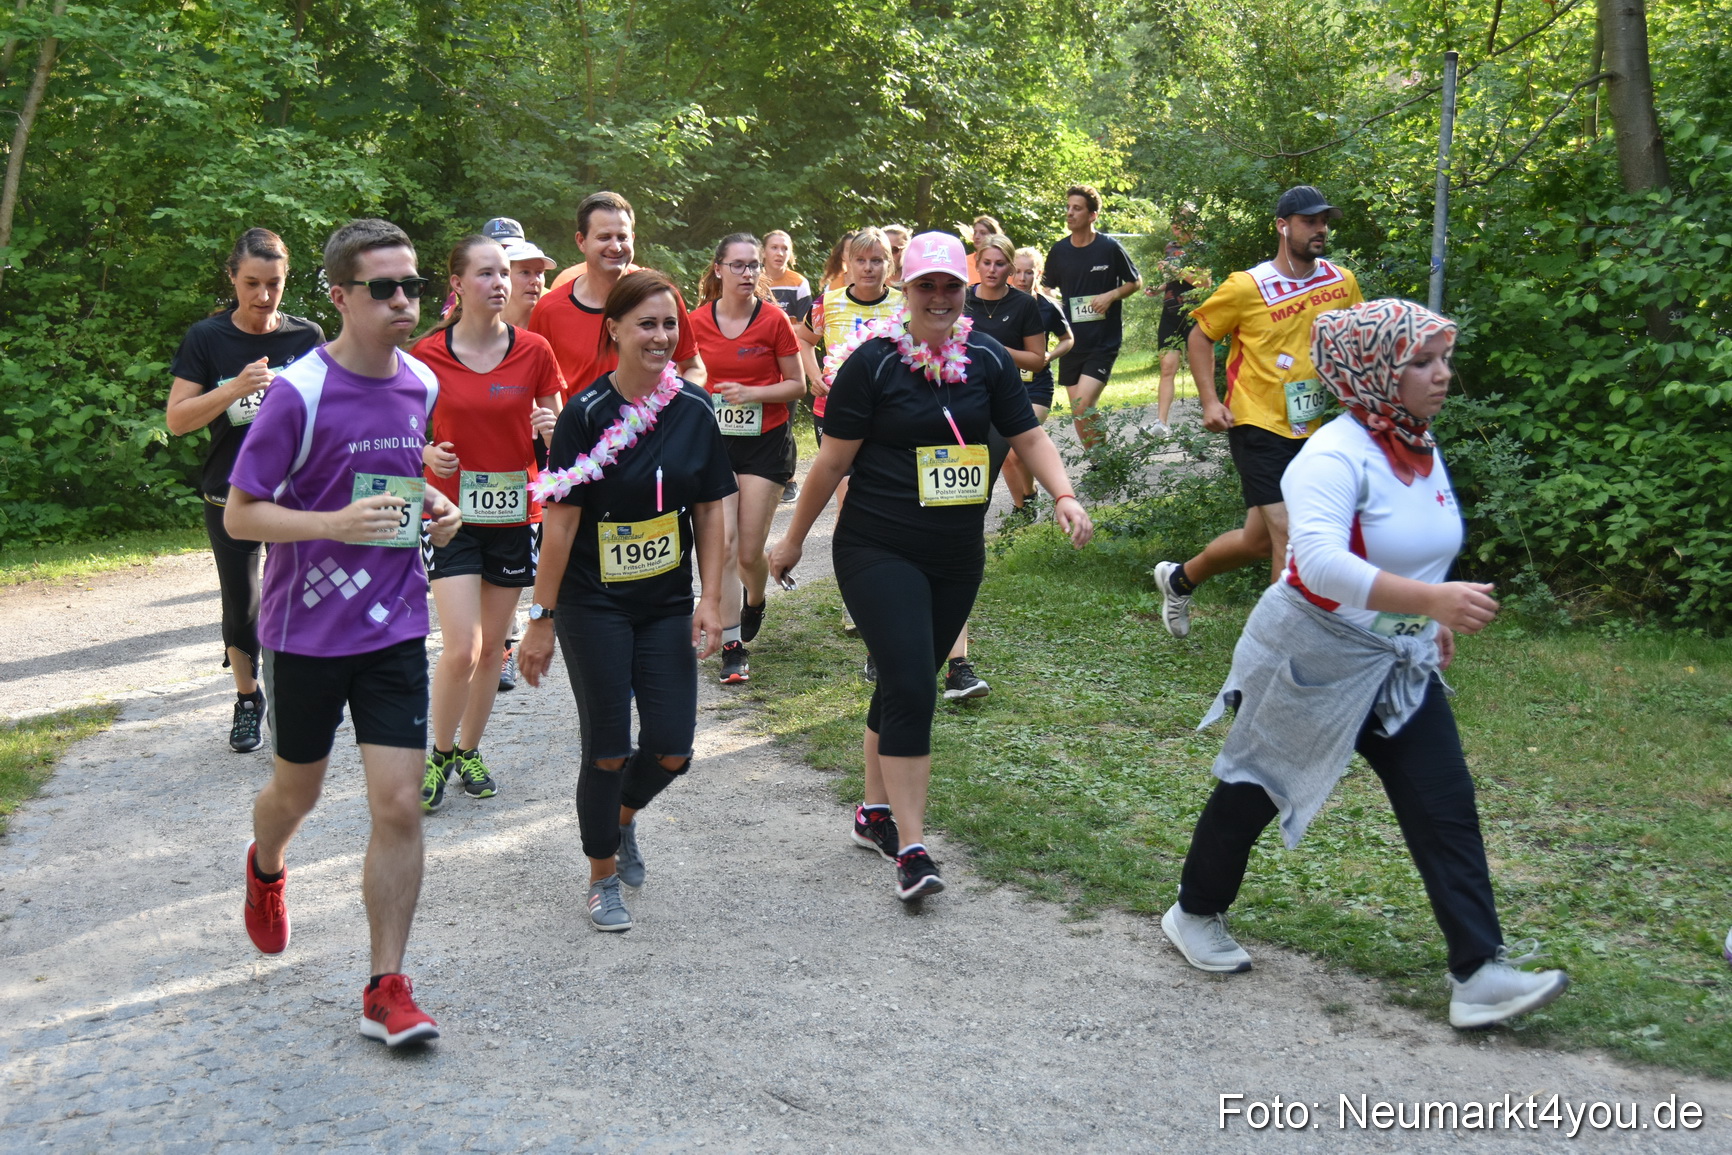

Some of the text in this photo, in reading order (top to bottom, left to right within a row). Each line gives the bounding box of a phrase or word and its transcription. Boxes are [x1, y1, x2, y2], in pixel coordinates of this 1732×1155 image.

[922, 240, 952, 264] LA
[1075, 305, 1098, 315] 140
[1270, 288, 1348, 323] MAX BÖGL
[1293, 391, 1324, 410] 1705
[716, 408, 755, 424] 1032
[348, 440, 371, 454] WIR
[374, 437, 399, 450] SIND
[929, 466, 981, 489] 1990
[468, 490, 519, 509] 1033
[610, 536, 671, 565] 1962
[623, 563, 646, 571] Fritsch
